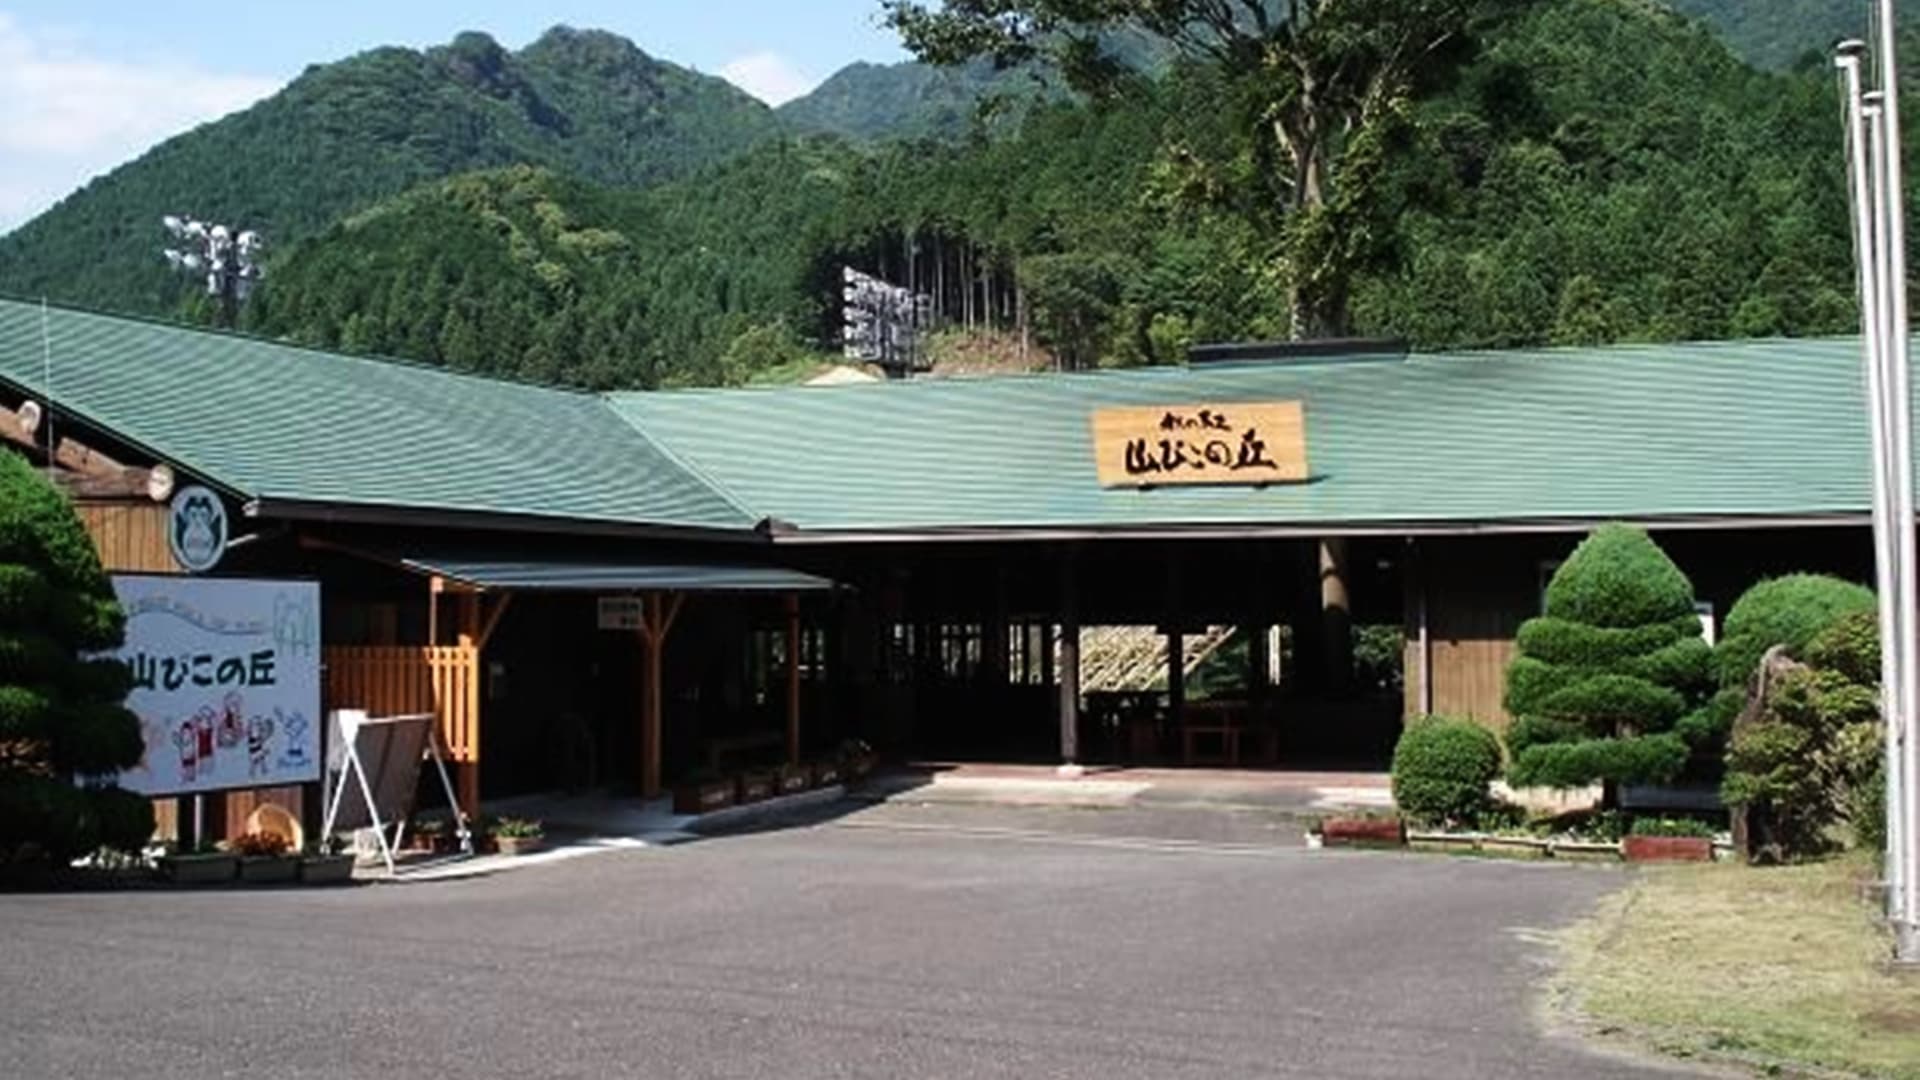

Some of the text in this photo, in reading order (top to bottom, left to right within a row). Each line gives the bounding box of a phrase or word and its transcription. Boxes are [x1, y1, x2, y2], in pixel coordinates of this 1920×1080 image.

[1125, 428, 1278, 475] 山びこの丘
[129, 650, 276, 691] 山びこの丘
